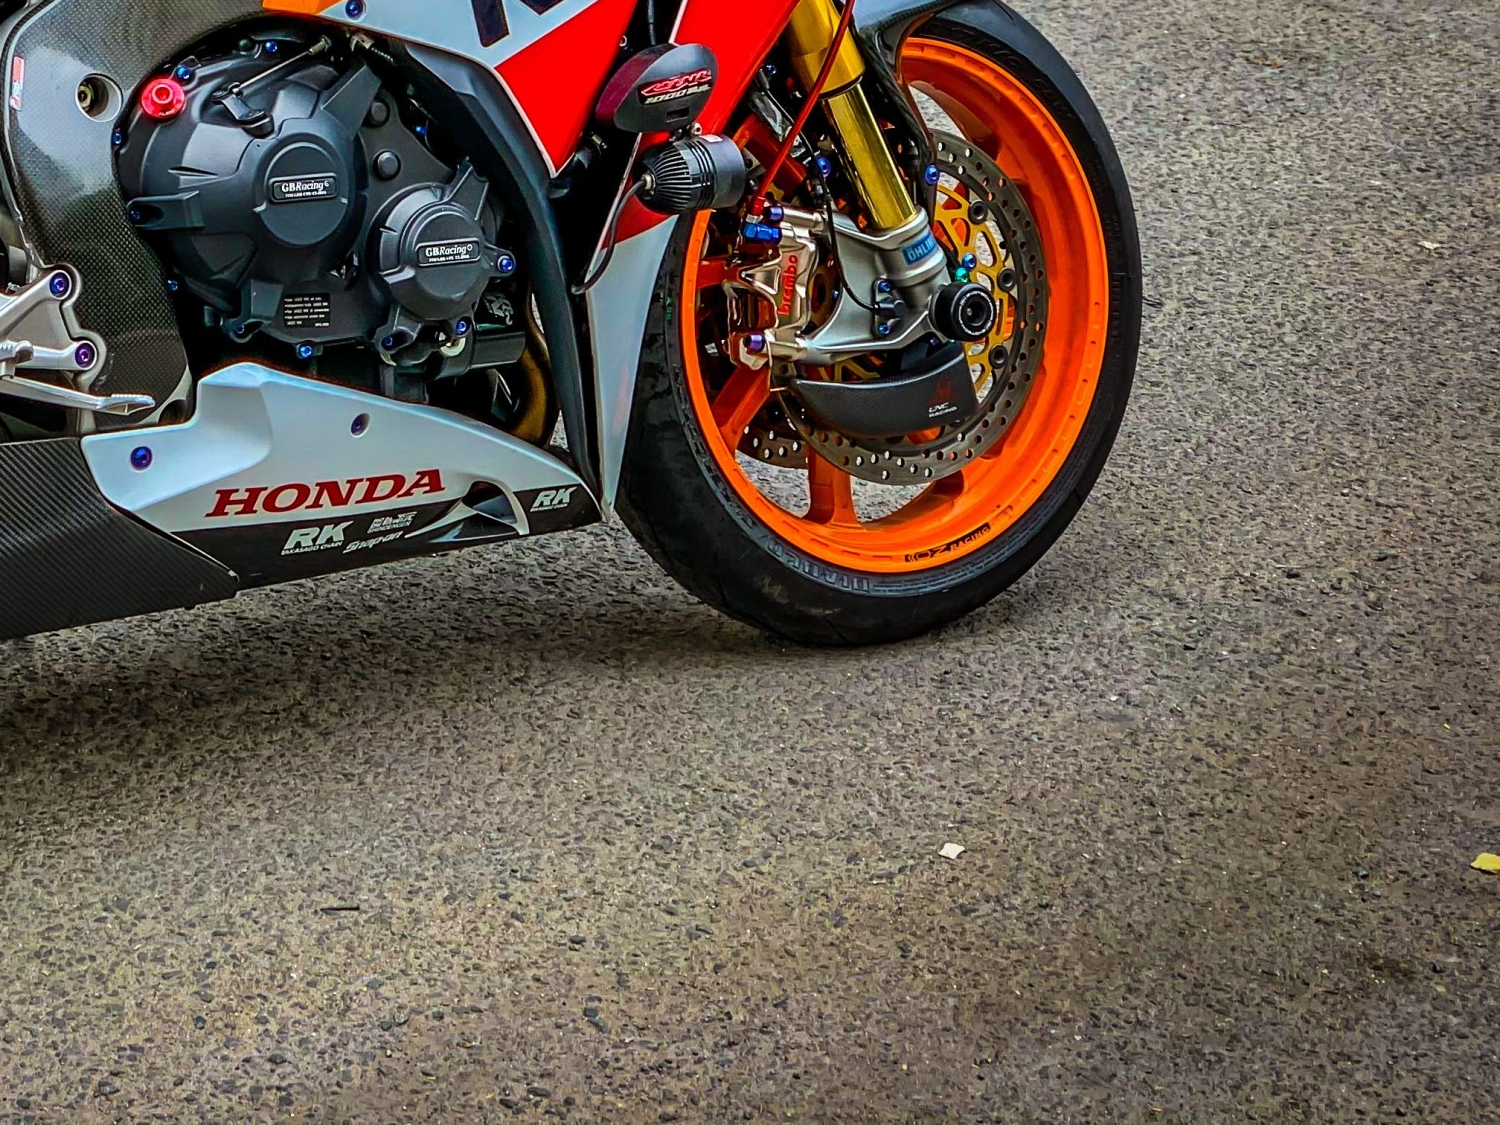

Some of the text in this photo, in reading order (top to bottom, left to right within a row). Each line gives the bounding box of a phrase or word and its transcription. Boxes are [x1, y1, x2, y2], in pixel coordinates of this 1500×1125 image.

[777, 254, 798, 316] brembo
[205, 468, 445, 518] HONDA
[533, 486, 578, 507] RK
[283, 520, 354, 550] RK
